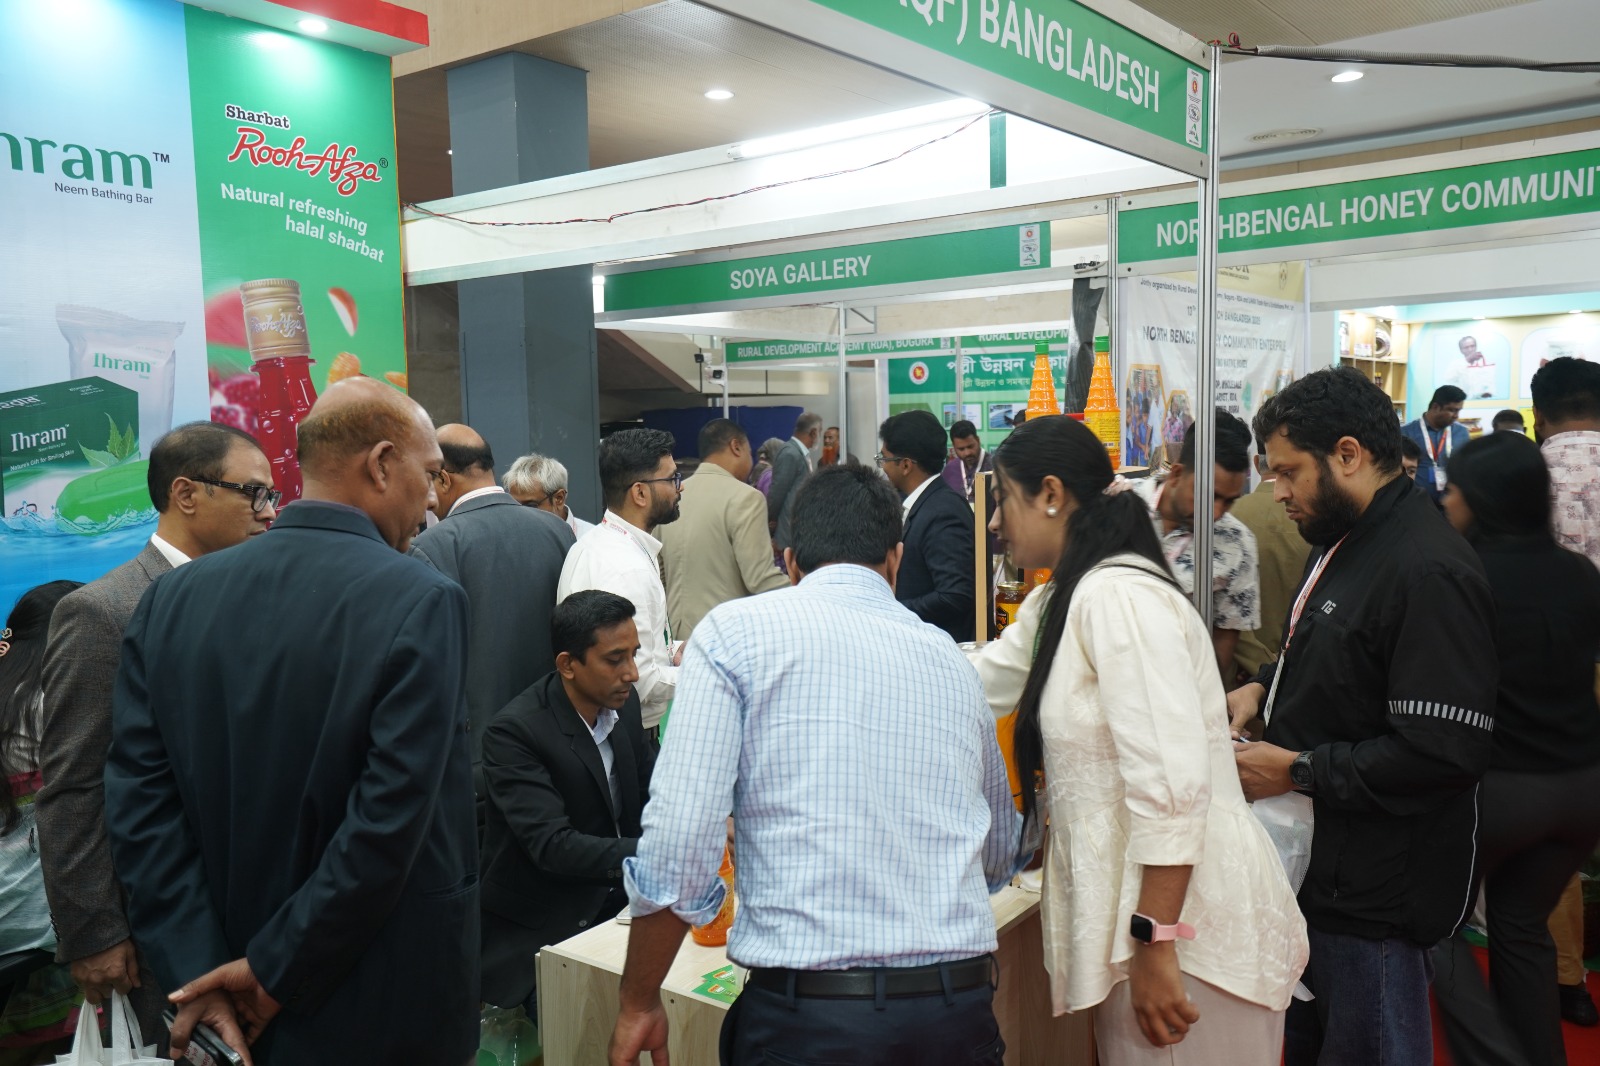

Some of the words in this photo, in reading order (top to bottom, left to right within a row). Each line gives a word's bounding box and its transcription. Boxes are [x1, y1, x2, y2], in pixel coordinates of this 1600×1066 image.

[980, 0, 1160, 112] BANGLADESH
[225, 104, 290, 129] Sharbat
[228, 127, 382, 196] Rooh-Afza
[54, 182, 88, 196] Neem
[91, 187, 133, 203] Bathing
[136, 193, 153, 204] Bar
[221, 183, 284, 208] Natural
[289, 198, 368, 237] refreshing
[1157, 201, 1333, 247] NORHBENGAL
[1340, 188, 1434, 226] HONEY
[285, 214, 325, 240] halal
[328, 231, 385, 263] sharbat
[730, 266, 779, 290] SOYA
[783, 255, 872, 284] GALLERY
[737, 346, 763, 358] RURAL
[764, 342, 823, 356] DEVELOPMENT
[1142, 325, 1168, 342] NORTH
[1169, 328, 1198, 345] BENGA
[93, 352, 151, 374] Ihram
[11, 426, 67, 452] Ihram
